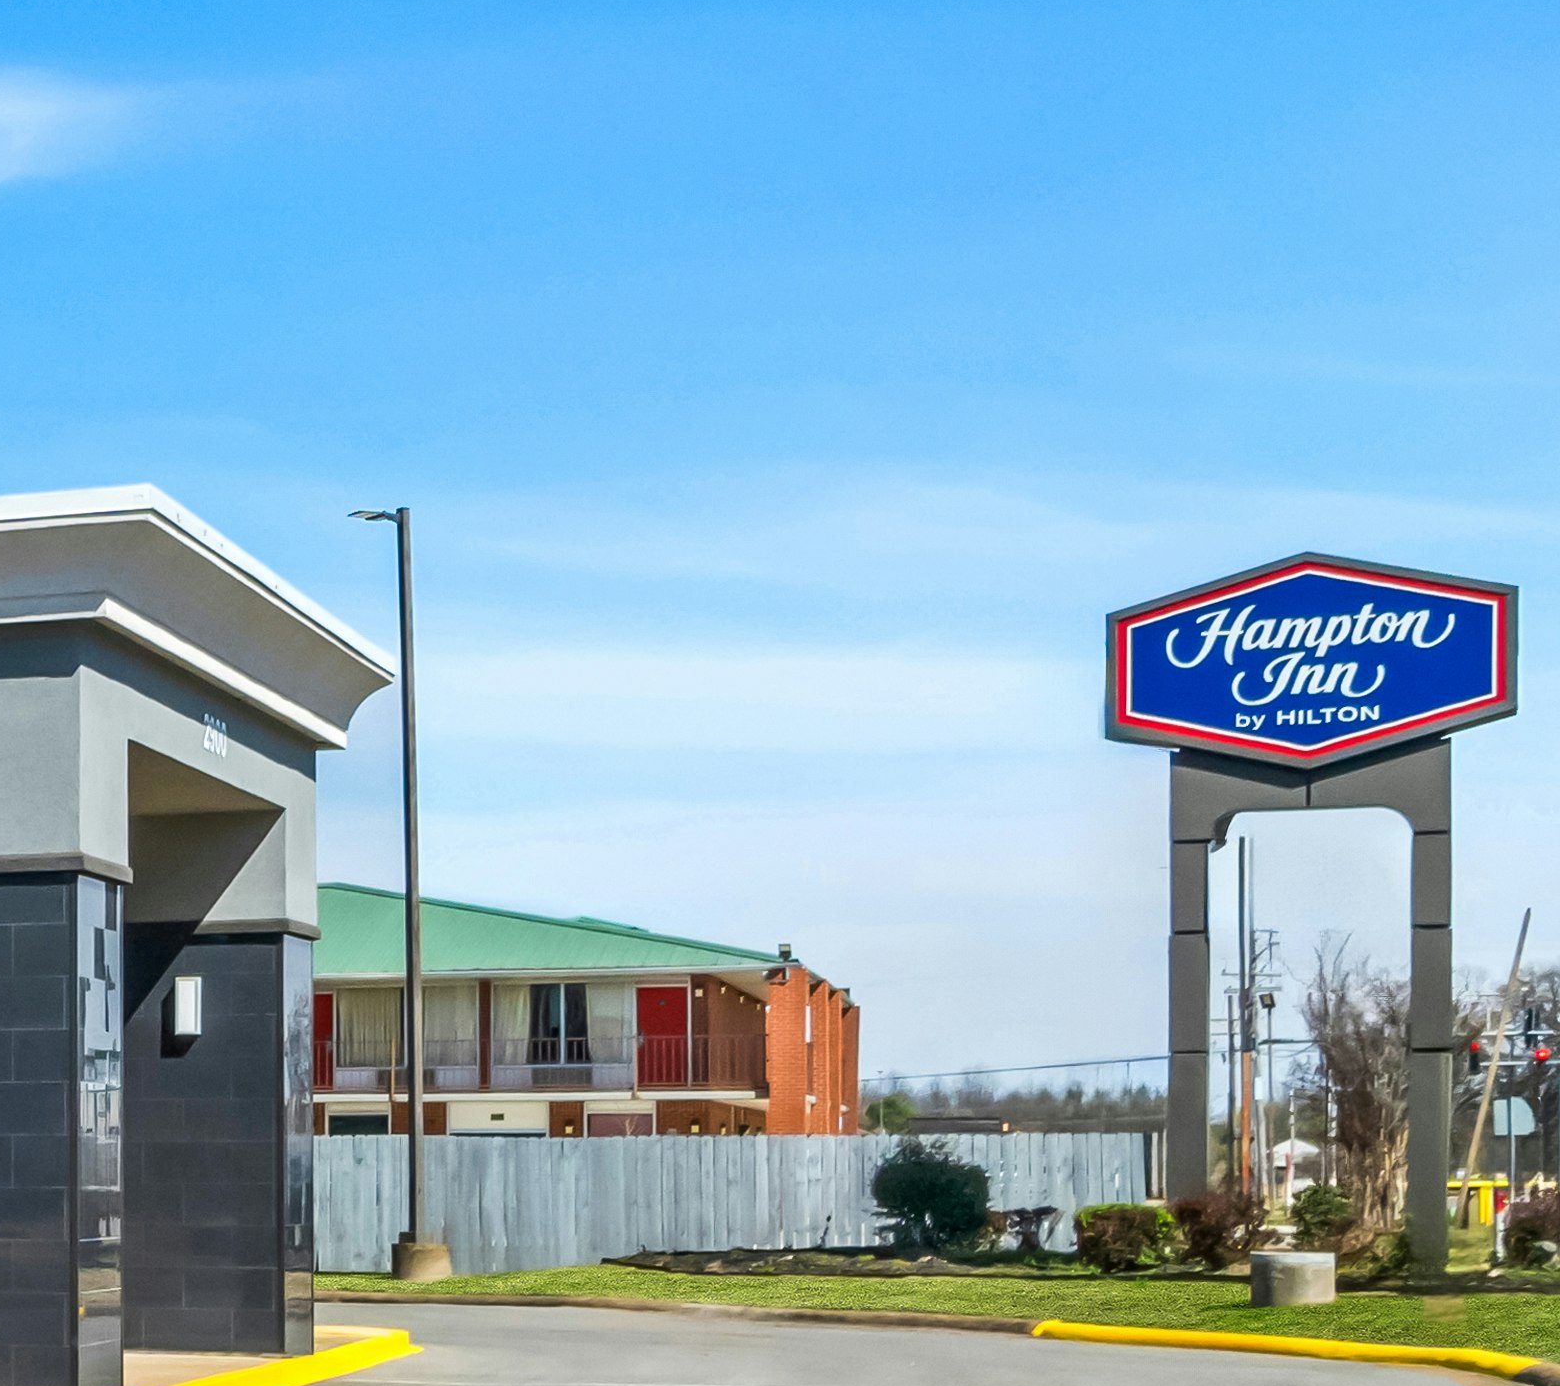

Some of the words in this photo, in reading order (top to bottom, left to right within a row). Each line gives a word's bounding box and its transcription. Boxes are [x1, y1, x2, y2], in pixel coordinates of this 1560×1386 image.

[1165, 602, 1455, 669] Hampton
[1231, 651, 1385, 706] Inn
[1234, 712, 1266, 731] by
[1276, 705, 1381, 726] HILTON
